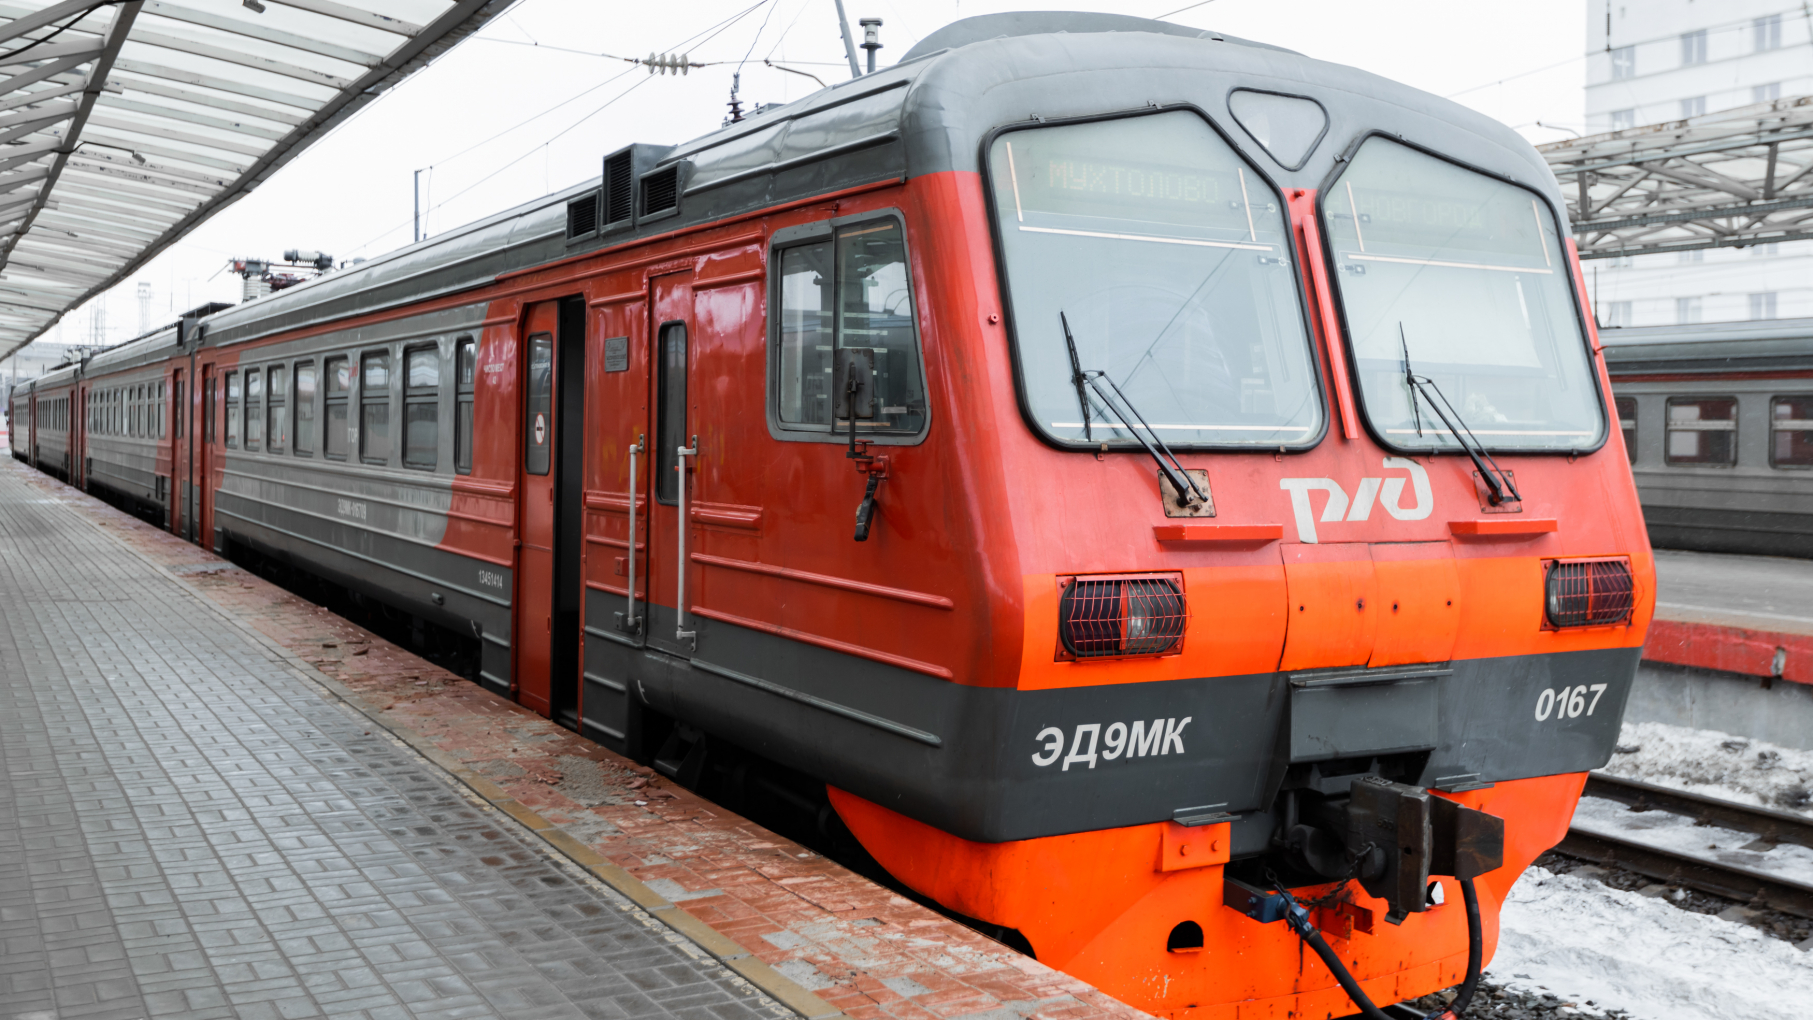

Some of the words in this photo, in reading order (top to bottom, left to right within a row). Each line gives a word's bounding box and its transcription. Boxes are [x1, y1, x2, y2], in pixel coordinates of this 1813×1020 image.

[1049, 160, 1218, 203] МУХТОЛОВО
[1360, 193, 1483, 228] НОВГОРОД
[478, 569, 503, 590] 13451414
[1534, 683, 1608, 722] 0167
[1031, 716, 1192, 771] ЭД9МК
